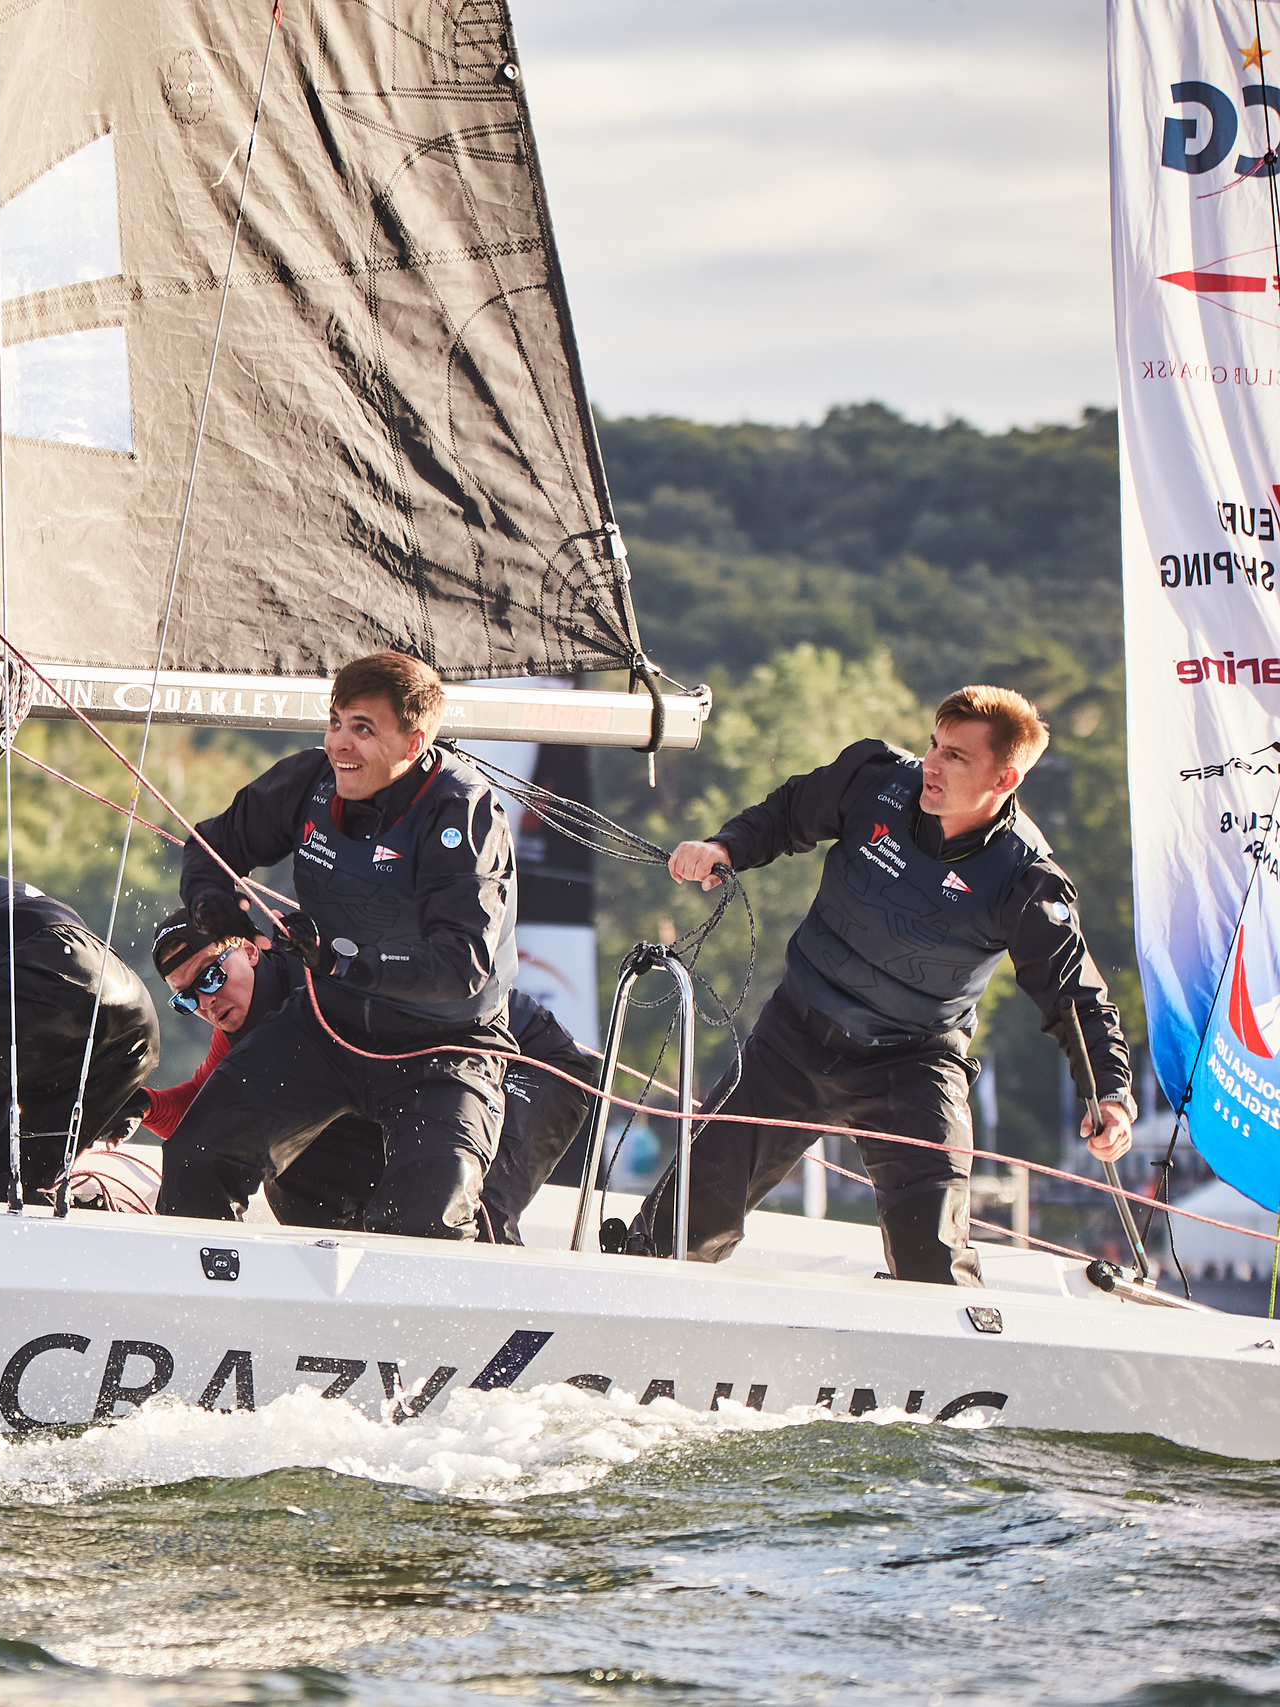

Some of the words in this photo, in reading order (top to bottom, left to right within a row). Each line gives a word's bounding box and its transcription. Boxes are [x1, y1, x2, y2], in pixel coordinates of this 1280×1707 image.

[165, 688, 290, 716] OAKLEY
[313, 830, 328, 844] EURO
[883, 836, 901, 852] EURO
[299, 848, 334, 870] Raymarine
[310, 840, 337, 860] SHIPPING
[877, 844, 907, 870] SHIPPING
[374, 863, 393, 873] YCG
[859, 845, 900, 879] Raymarine
[941, 888, 959, 902] YCG
[215, 1260, 228, 1268] RS
